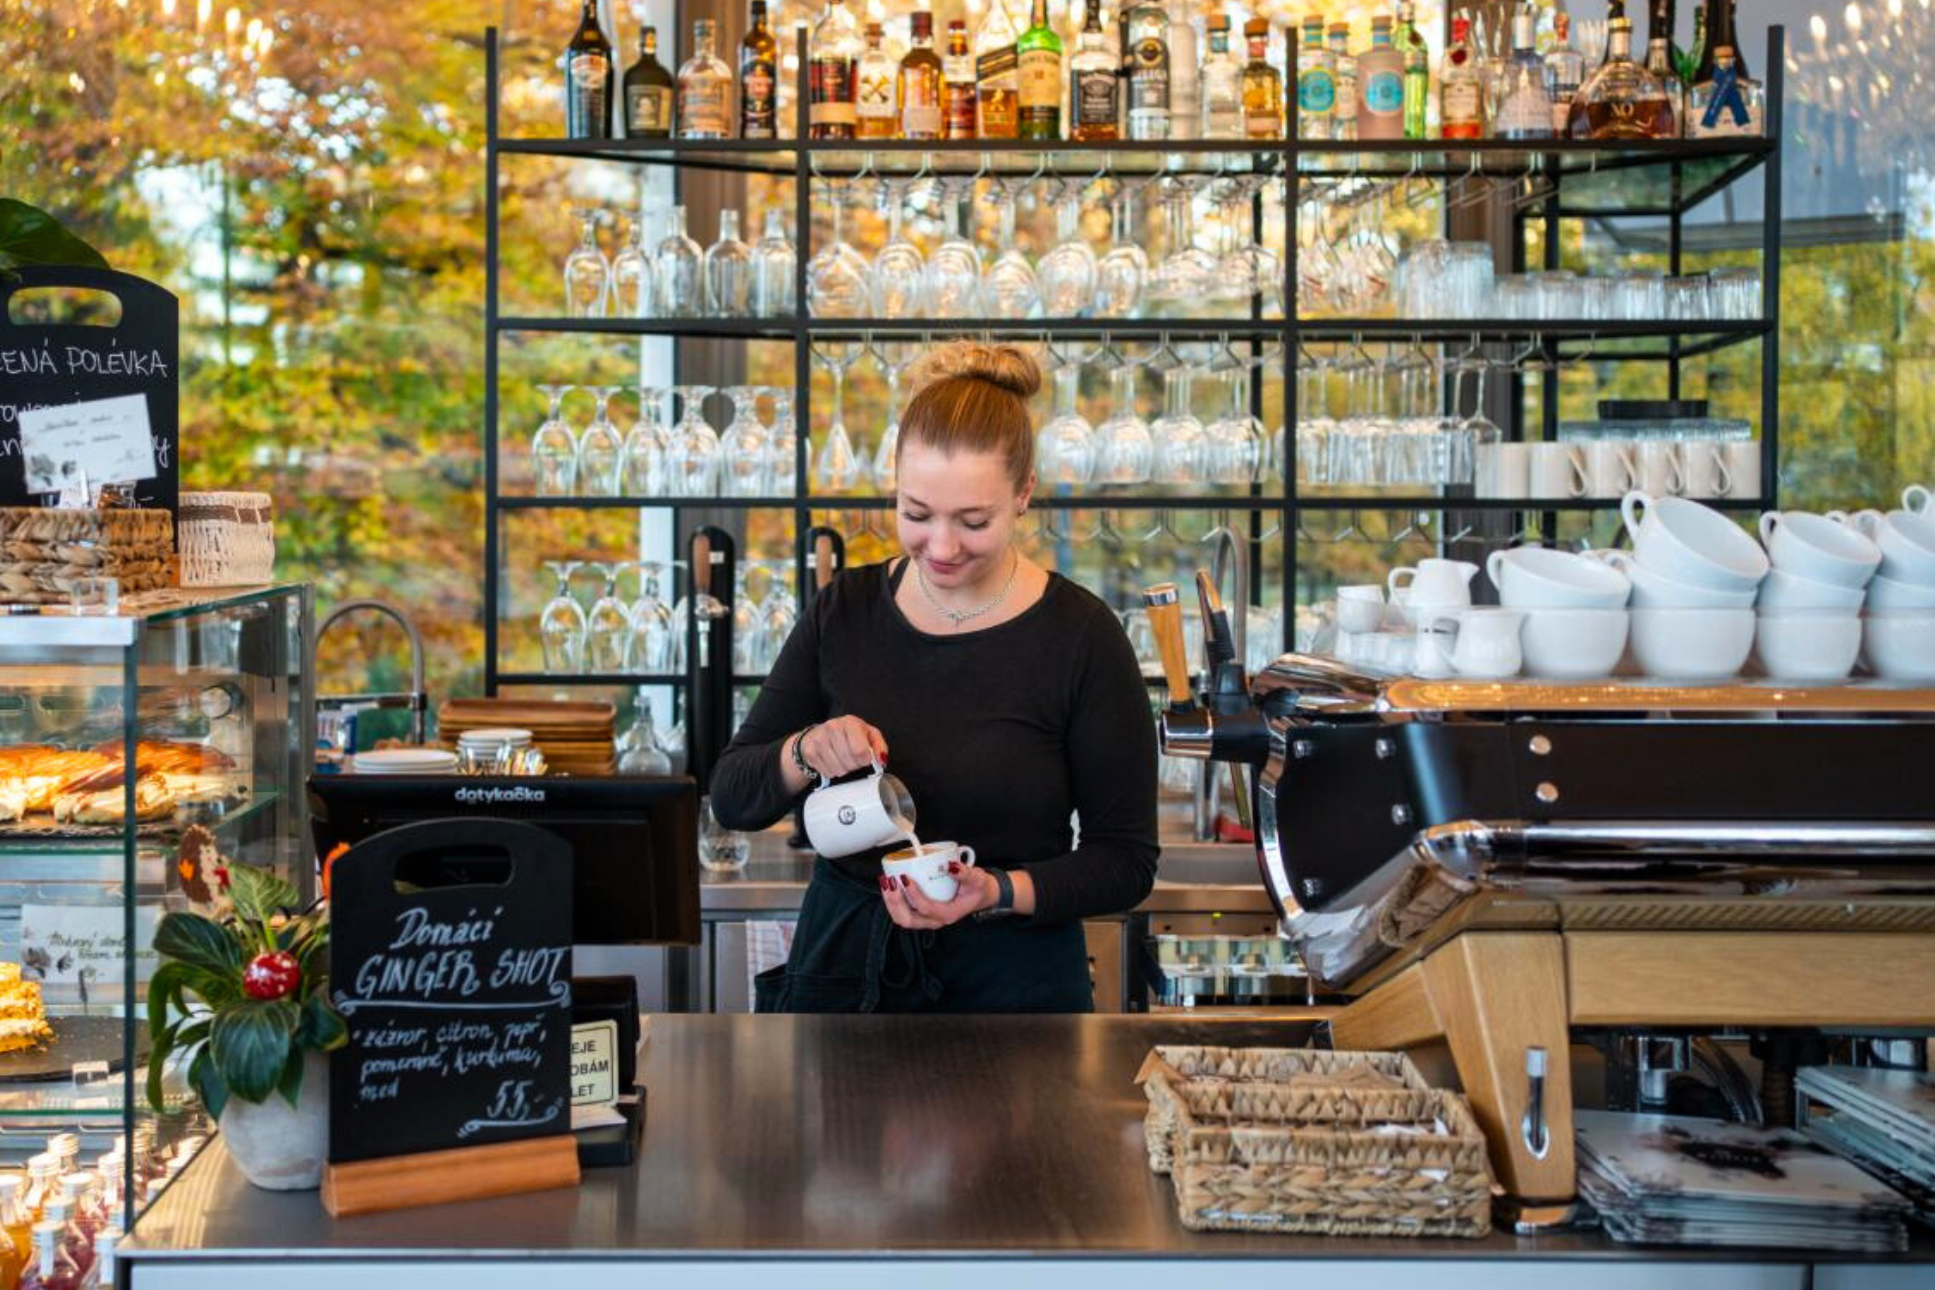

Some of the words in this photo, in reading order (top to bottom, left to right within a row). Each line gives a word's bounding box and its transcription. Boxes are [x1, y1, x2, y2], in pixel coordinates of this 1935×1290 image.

[0, 337, 58, 374] ENÁ
[66, 338, 168, 377] POLÉVKA
[455, 786, 545, 804] dotykačka
[389, 907, 503, 949] Domáci
[355, 950, 480, 999] GINGER
[490, 947, 571, 988] SHOT
